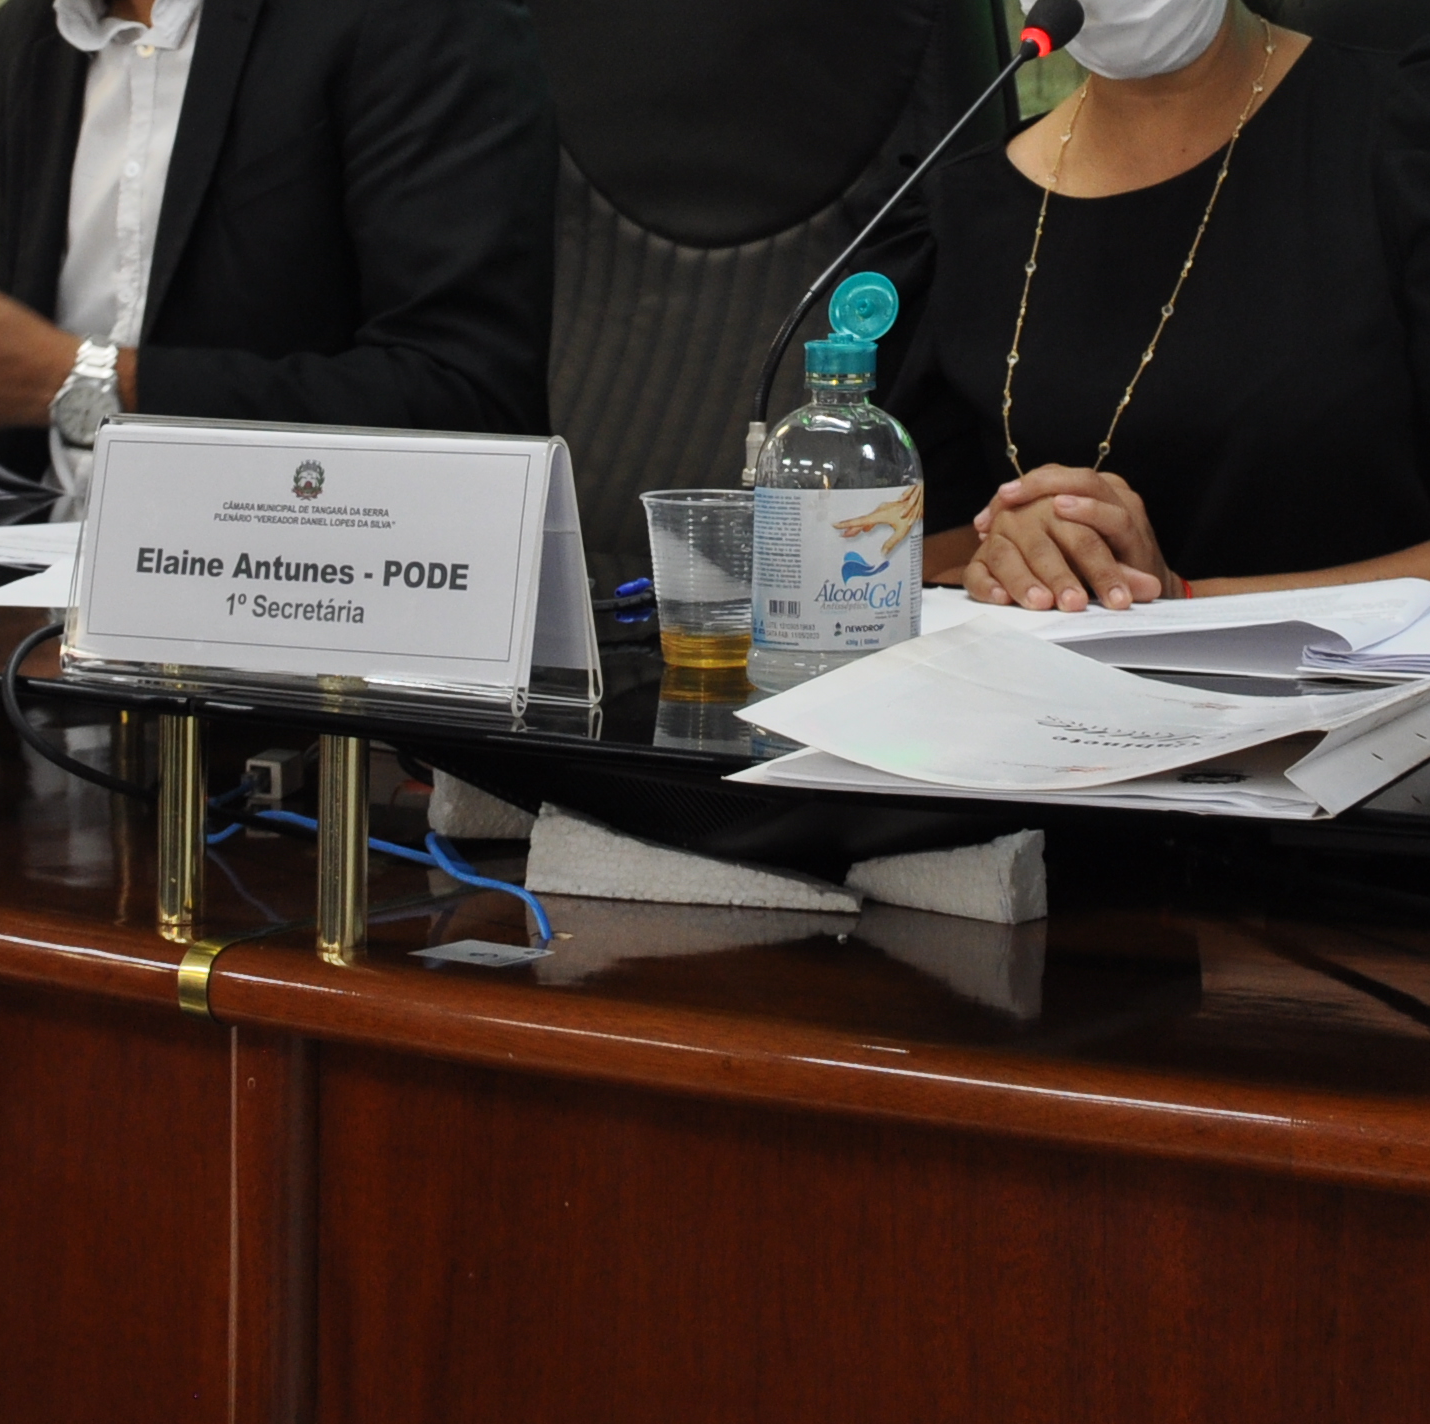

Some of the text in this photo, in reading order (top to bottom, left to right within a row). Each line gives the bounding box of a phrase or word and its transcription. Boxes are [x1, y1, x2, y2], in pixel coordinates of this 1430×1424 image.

[214, 513, 252, 522] PLENÁRIO
[300, 517, 328, 526] DANIEL
[330, 519, 356, 528] LOPES
[357, 520, 369, 528] DA
[222, 501, 389, 517] CÂMARA MUNICIPAL DE TANGARÁ DA SERRA
[136, 546, 224, 578] Elaine
[232, 552, 355, 585] Antunes
[382, 559, 470, 591] PODE
[251, 593, 366, 624] Secretária
